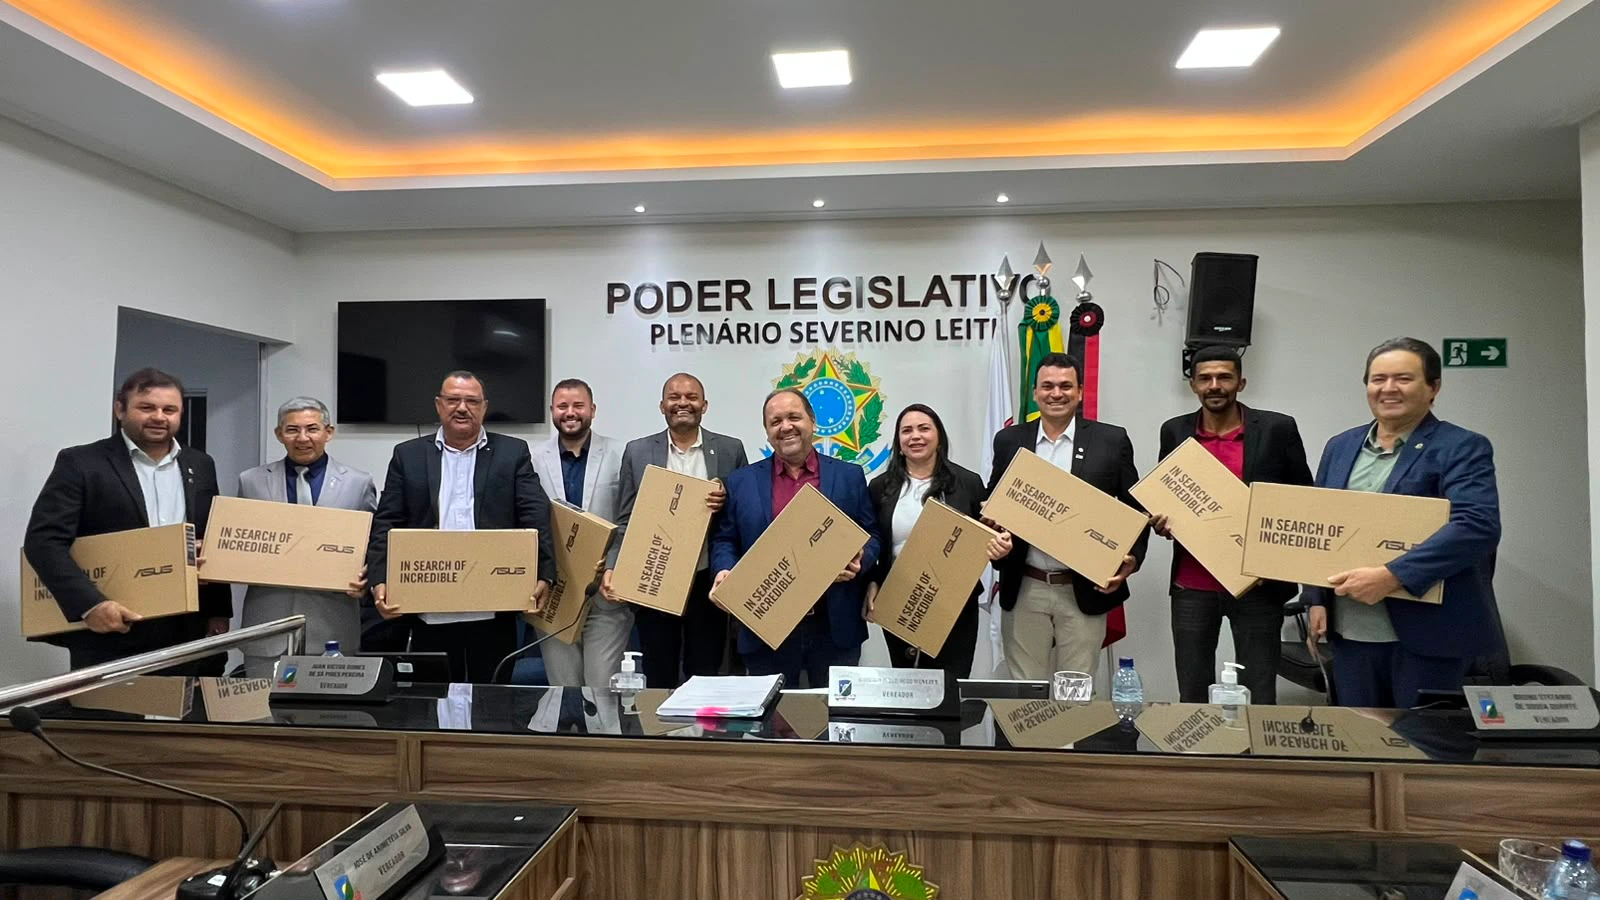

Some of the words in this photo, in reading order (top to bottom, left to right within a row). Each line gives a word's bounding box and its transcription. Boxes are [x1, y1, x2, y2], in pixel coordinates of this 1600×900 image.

[607, 280, 753, 315] PODER
[651, 318, 782, 345] PLENÁRIO
[790, 319, 925, 344] SEVERINO
[936, 319, 997, 341] LEIT
[669, 483, 683, 516] ASUS
[1012, 477, 1024, 489] IN
[1022, 483, 1057, 508] SEARCH
[1056, 502, 1070, 515] OF
[1160, 473, 1207, 517] INCREDIBLE
[1169, 465, 1182, 477] IN
[1178, 474, 1211, 505] SEARCH
[1207, 501, 1223, 513] OF
[1006, 487, 1056, 522] INCREDIBLE
[220, 527, 232, 538] IN
[234, 528, 277, 542] SEARCH
[279, 532, 293, 543] OF
[565, 522, 579, 552] ASUS
[652, 533, 663, 546] OF
[809, 516, 834, 548] ASUS
[1084, 528, 1119, 550] ASUS
[1259, 531, 1331, 551] INCREDIBLE
[1261, 517, 1273, 529] IN
[1276, 519, 1324, 535] SEARCH
[1328, 525, 1344, 538] OF
[217, 539, 281, 554] INCREDIBLE
[316, 543, 355, 554] ASUS
[943, 526, 963, 558] ASUS
[1376, 539, 1421, 551] ASU
[94, 566, 107, 578] OF
[134, 564, 173, 578] ASUS
[400, 561, 410, 571] IN
[413, 560, 451, 571] SEARCH
[454, 560, 467, 571] OF
[400, 572, 458, 583] INCREDIBLE
[490, 567, 526, 575] ASUS
[641, 547, 659, 582] SEARCH
[648, 544, 672, 597] INCREDIBLE
[637, 583, 648, 593] IN
[743, 598, 756, 612] IN
[752, 567, 781, 601] SEARCH
[778, 556, 791, 572] OF
[752, 571, 796, 620] INCREDIBLE
[896, 615, 908, 627] IN
[902, 583, 926, 616] SEARCH
[920, 571, 931, 585] OF
[906, 584, 939, 633] INCREDIBLE
[882, 690, 914, 698] VEREADOR
